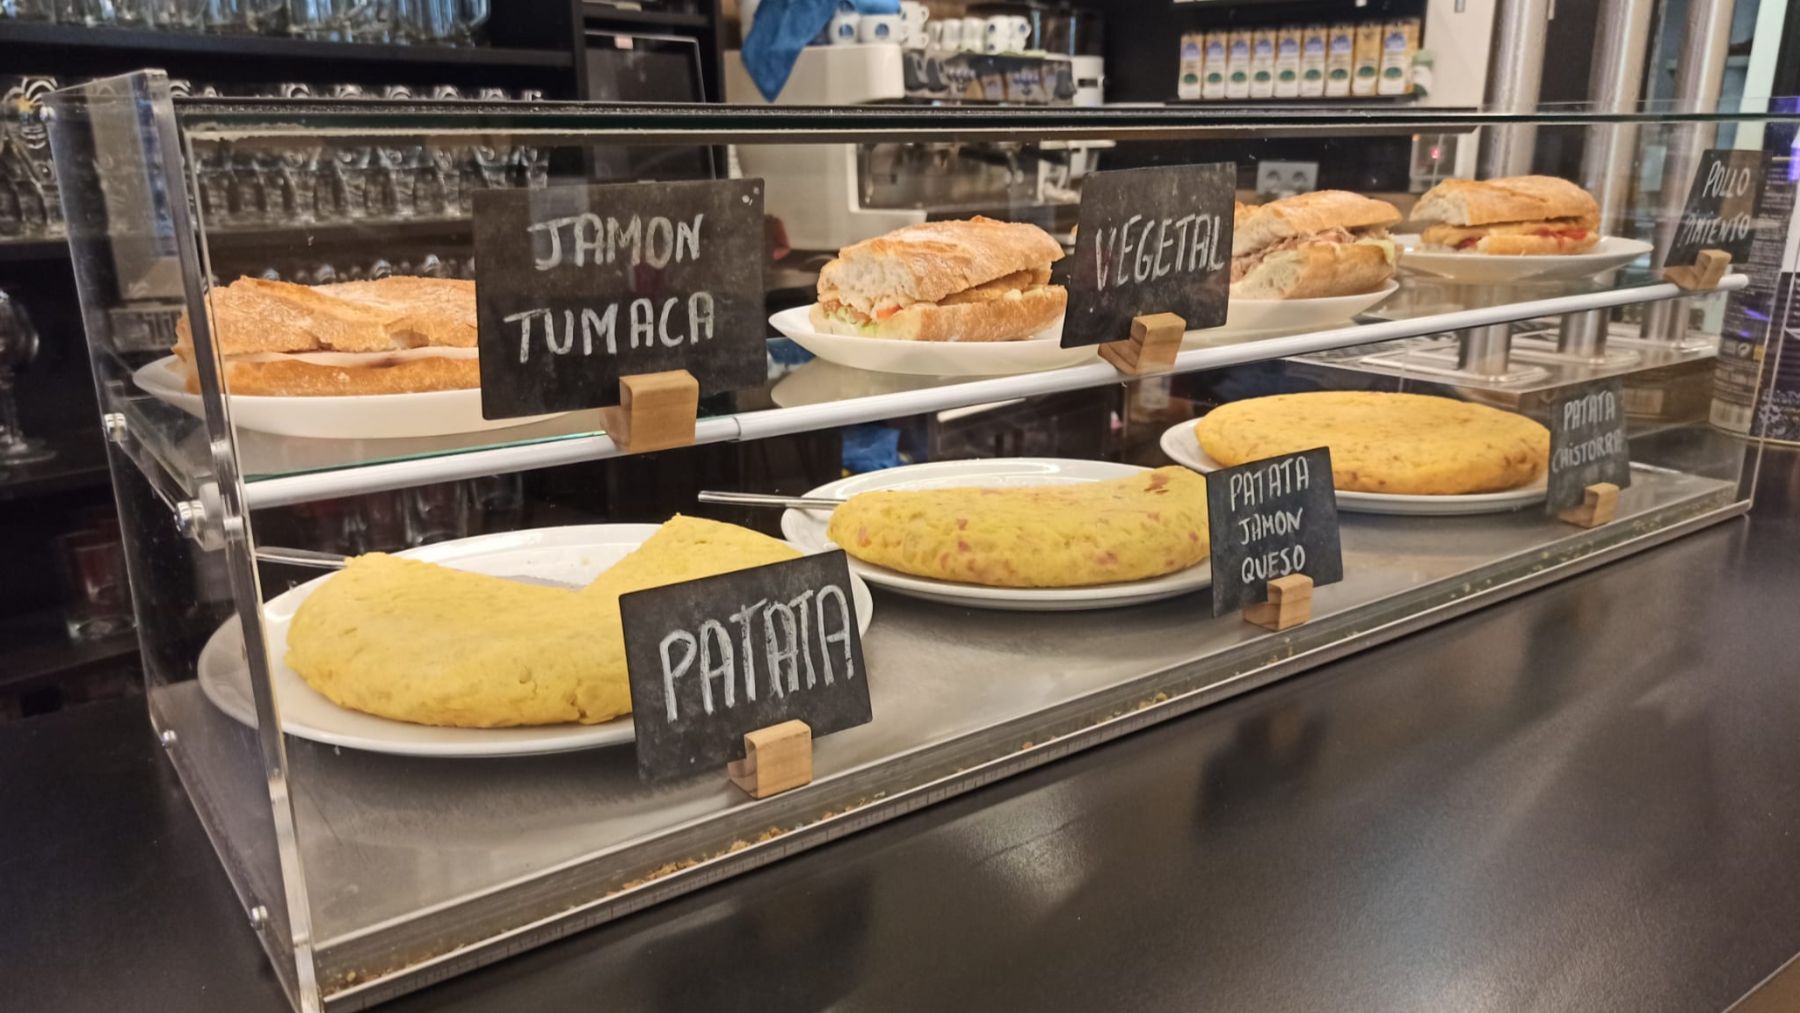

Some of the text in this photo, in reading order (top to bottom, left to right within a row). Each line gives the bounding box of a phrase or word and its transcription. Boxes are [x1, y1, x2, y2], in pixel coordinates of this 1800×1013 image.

[1702, 160, 1751, 198] POLLO
[527, 212, 704, 271] JAMON
[1095, 213, 1225, 292] VEGETAL
[503, 291, 715, 364] TUMACA
[1563, 390, 1616, 432] PATATA
[1229, 455, 1310, 513] PATATA
[1238, 506, 1304, 546] JAMON
[1241, 544, 1306, 584] QUESO
[659, 584, 855, 725] PATATA
